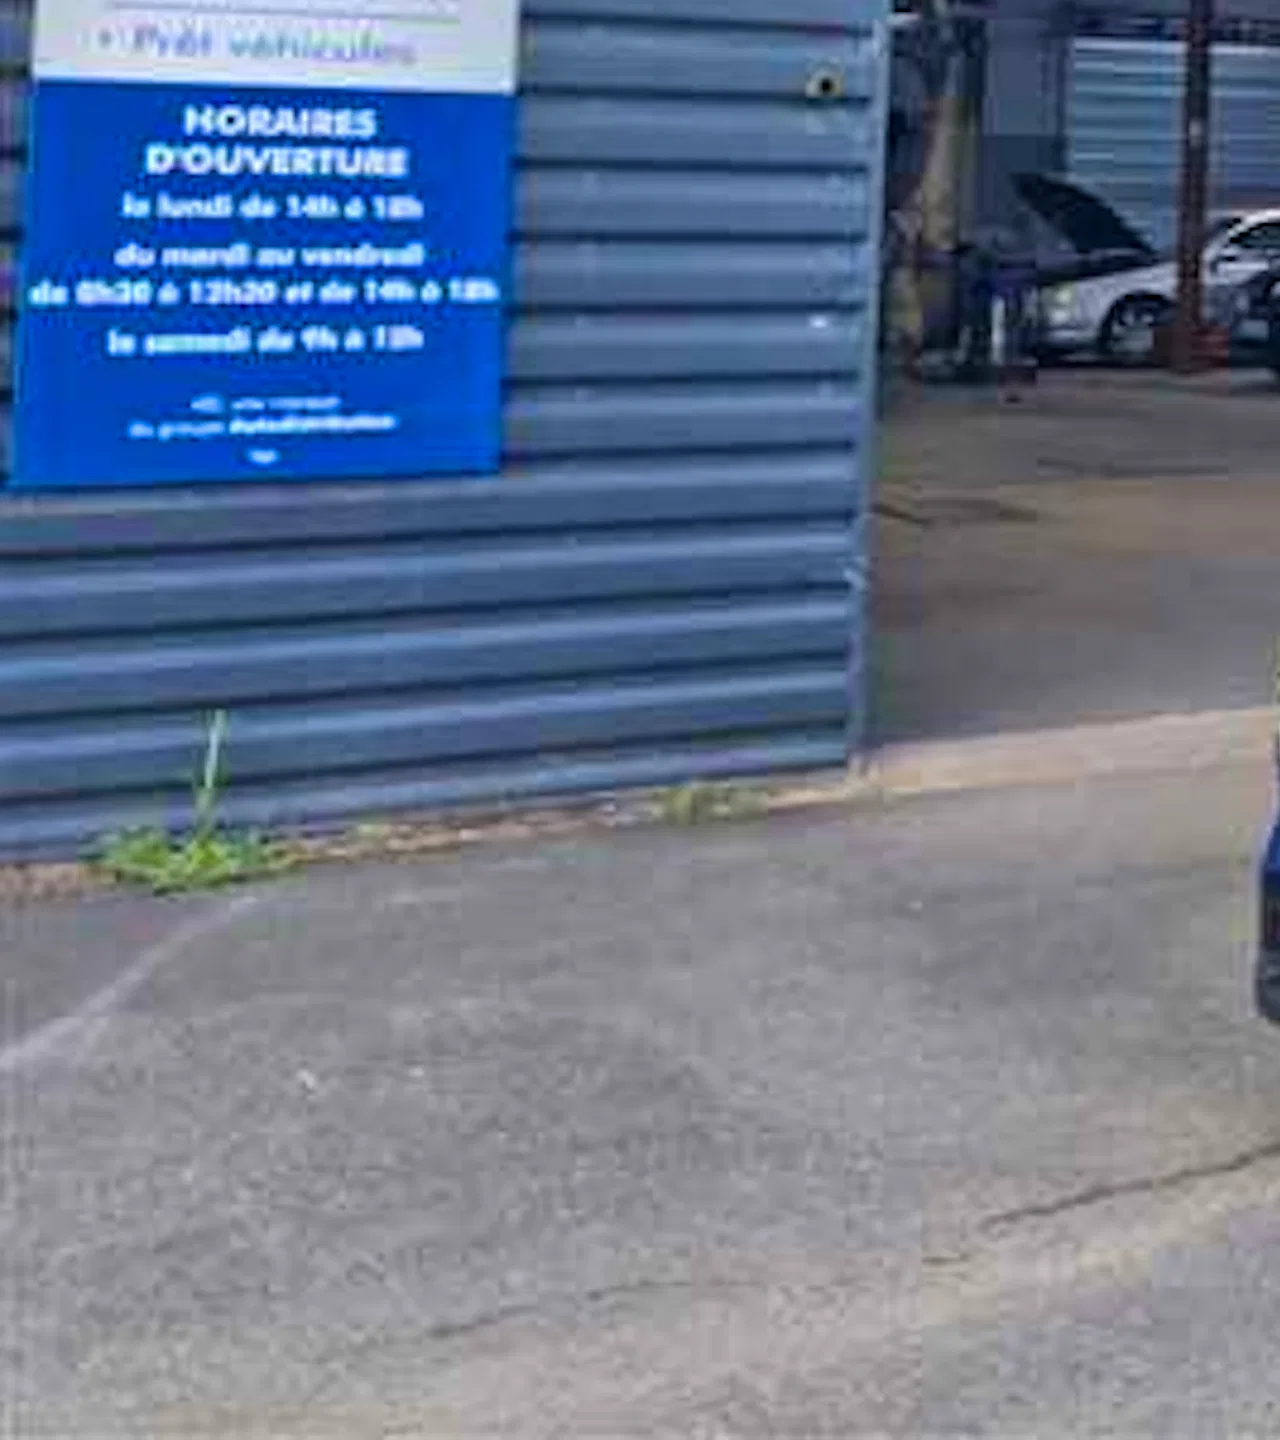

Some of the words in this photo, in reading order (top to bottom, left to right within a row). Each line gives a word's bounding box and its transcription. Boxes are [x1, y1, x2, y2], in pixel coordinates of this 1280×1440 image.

[183, 104, 378, 138] HORAIRES
[145, 143, 410, 177] D'OUVERTURE
[122, 191, 151, 219] le
[156, 191, 233, 219] lundi
[239, 193, 276, 219] de
[113, 242, 156, 268] du
[161, 242, 249, 268] mardi
[257, 247, 295, 268] au
[301, 241, 425, 267] vendredi
[28, 277, 69, 305] de
[283, 279, 314, 305] et
[318, 277, 358, 305] de
[107, 327, 137, 357] le
[142, 325, 250, 355] samedi
[257, 324, 295, 353] de
